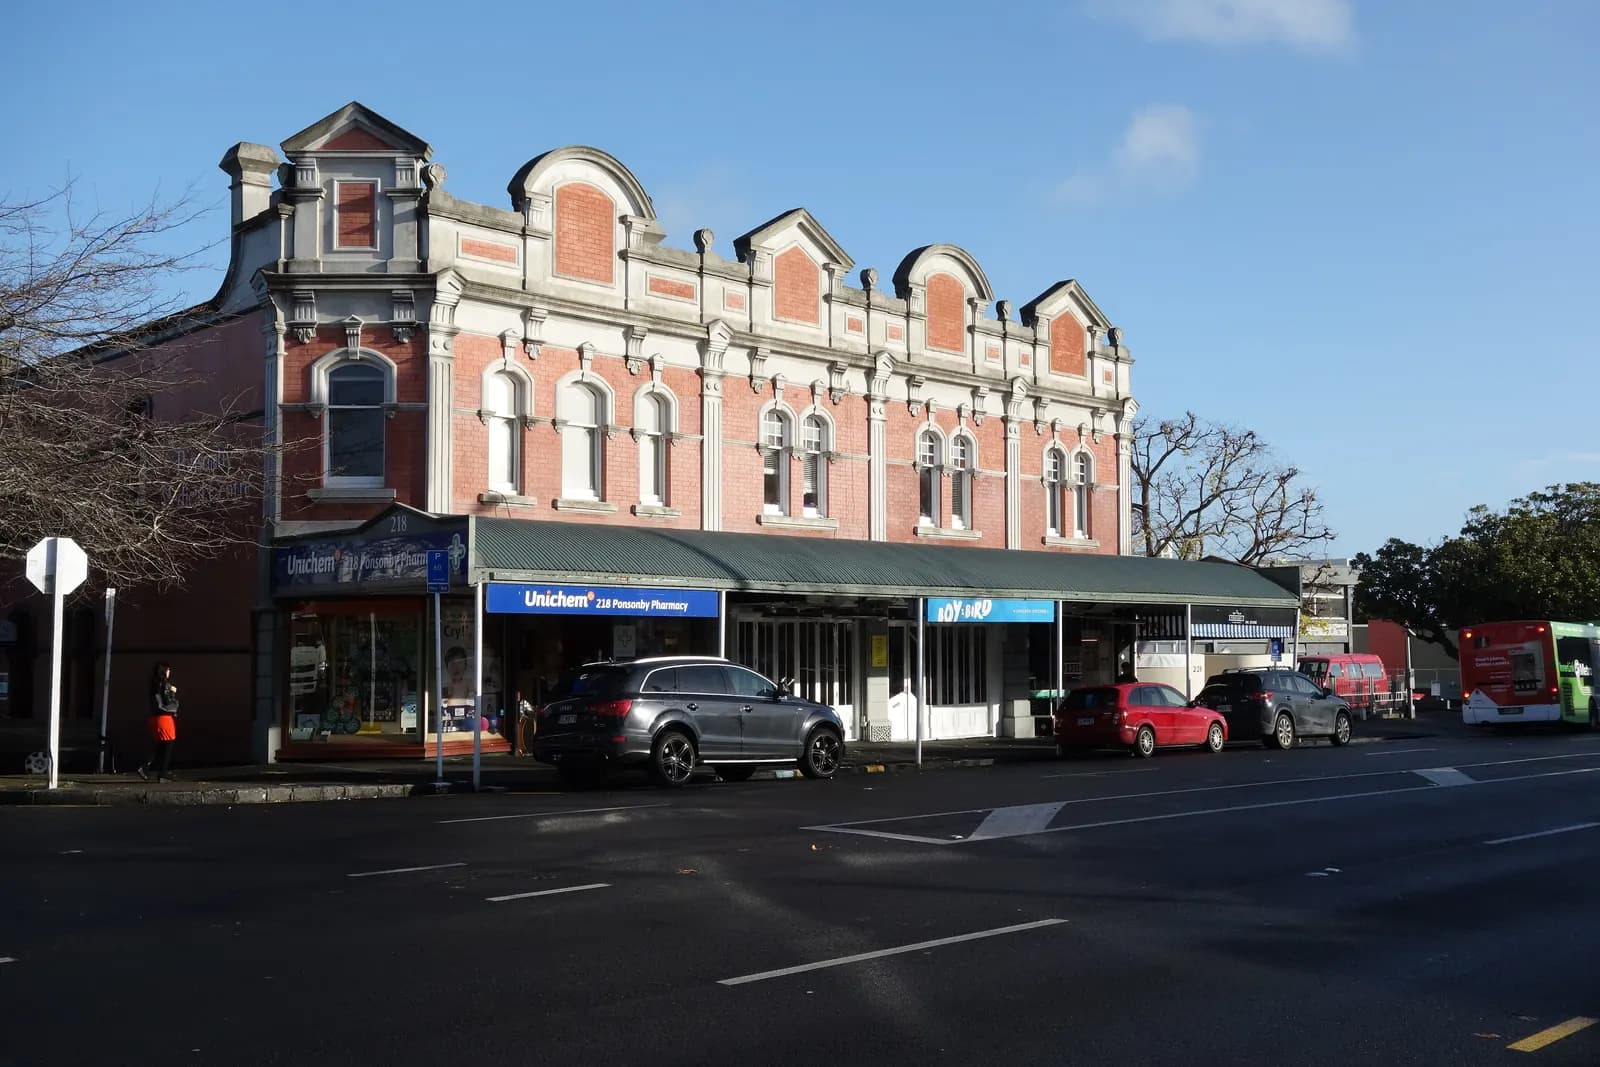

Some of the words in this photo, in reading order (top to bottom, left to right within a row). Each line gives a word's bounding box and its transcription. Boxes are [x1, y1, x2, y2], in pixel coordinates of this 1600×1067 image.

[390, 515, 407, 533] 218
[287, 551, 336, 575] Unichem
[400, 548, 427, 568] Pharm
[434, 552, 441, 560] P
[524, 589, 589, 608] Unichem
[595, 598, 611, 609] 218
[612, 599, 650, 612] Ponsonby
[651, 600, 689, 613] Pharmacy
[937, 599, 963, 623] BOY
[965, 599, 993, 620] BIRD
